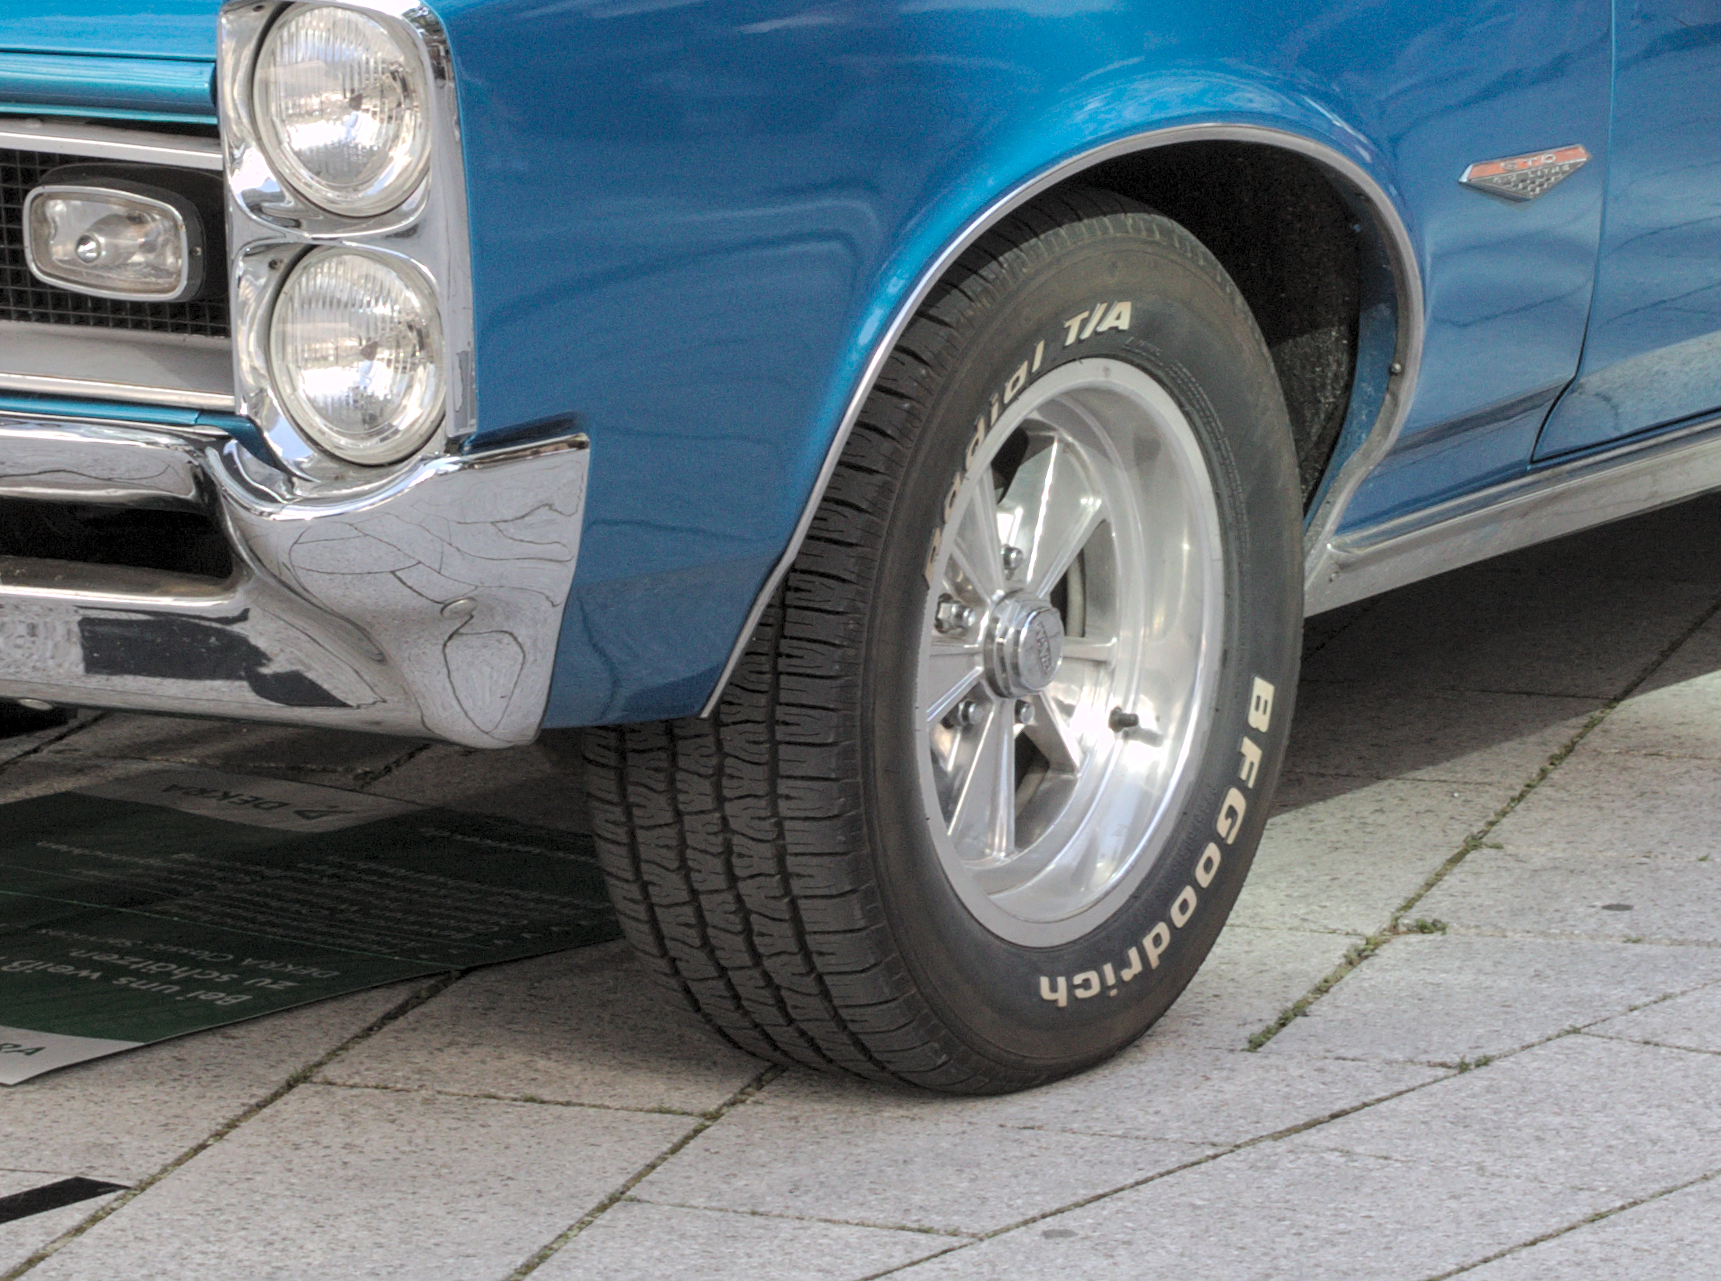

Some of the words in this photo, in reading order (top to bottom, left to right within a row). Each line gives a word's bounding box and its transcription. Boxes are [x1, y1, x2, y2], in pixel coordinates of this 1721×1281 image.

[1500, 153, 1556, 172] GTO
[1063, 301, 1132, 348] T/A
[162, 783, 290, 810] DEKRA
[1039, 676, 1275, 1008] BFGoodrich
[0, 958, 103, 982] weiß
[111, 976, 180, 995] uns
[243, 976, 302, 991] zu
